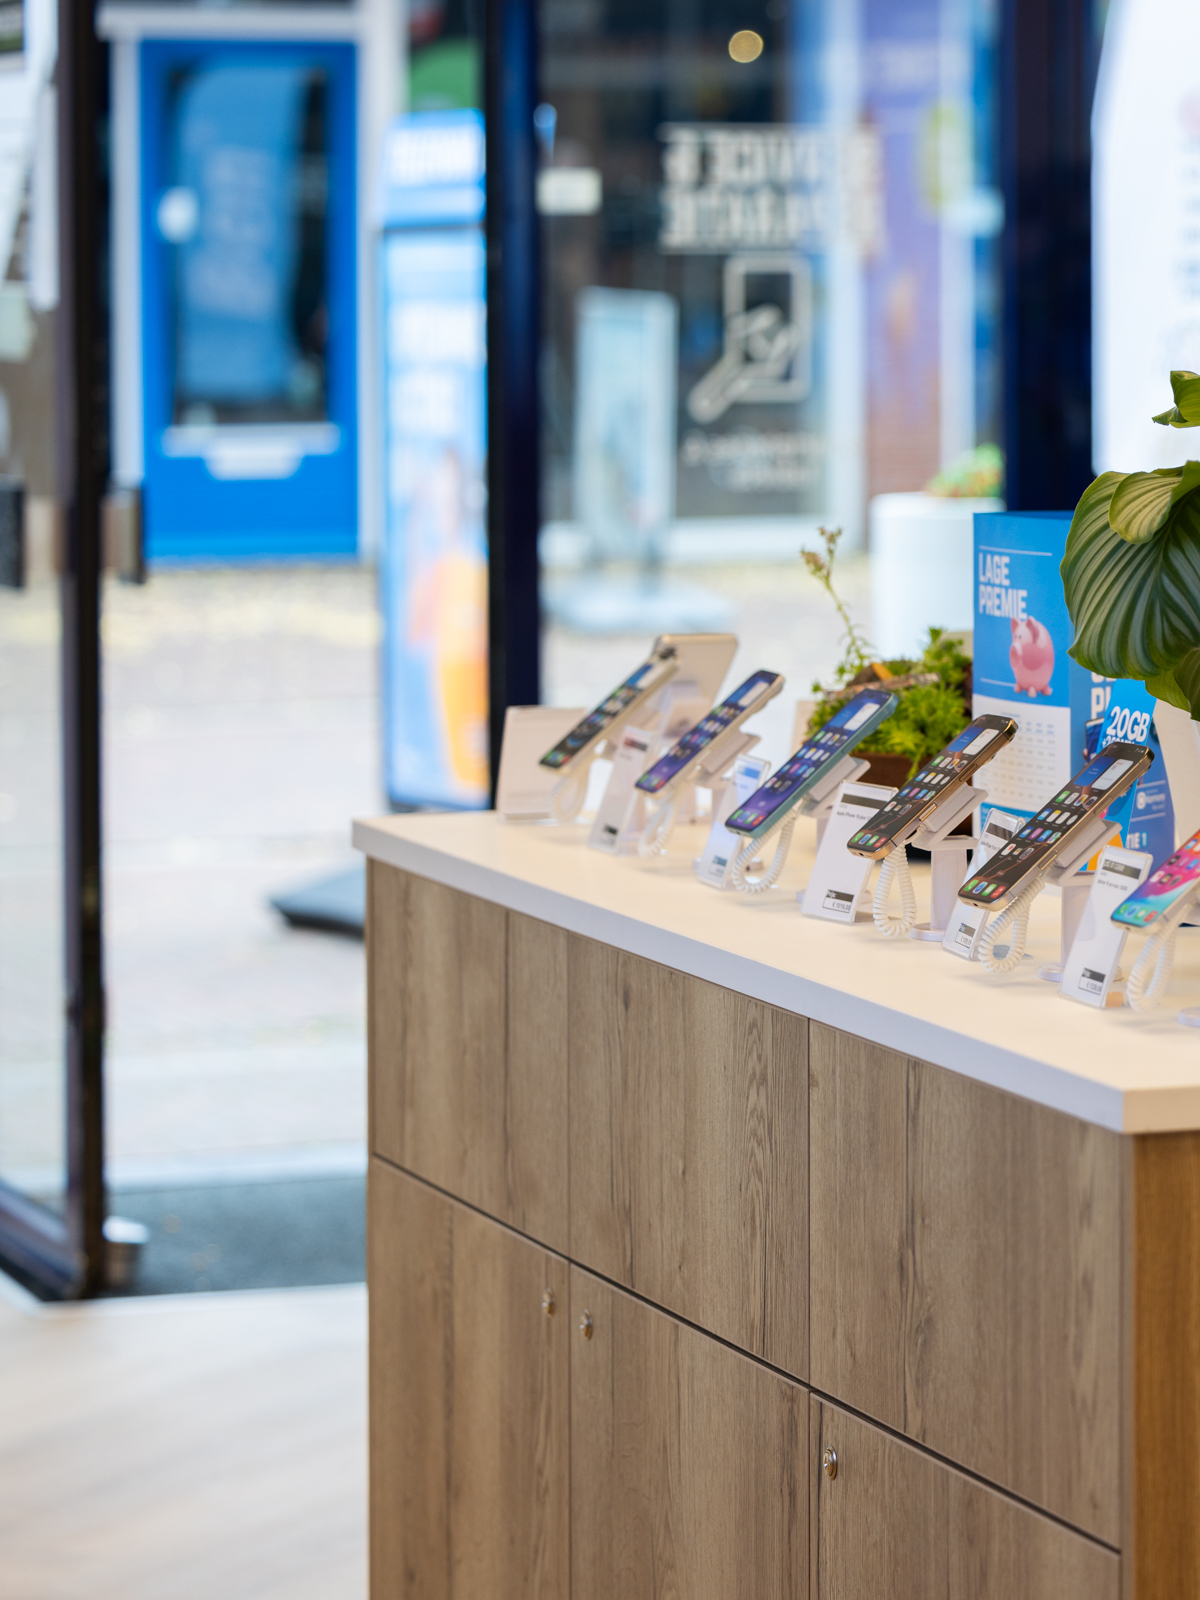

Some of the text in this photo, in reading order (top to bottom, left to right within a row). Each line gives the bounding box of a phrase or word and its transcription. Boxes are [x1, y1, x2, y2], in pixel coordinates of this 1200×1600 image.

[979, 552, 1010, 587] LAGE
[979, 584, 1028, 619] PREMIE
[1106, 706, 1150, 743] 20GB
